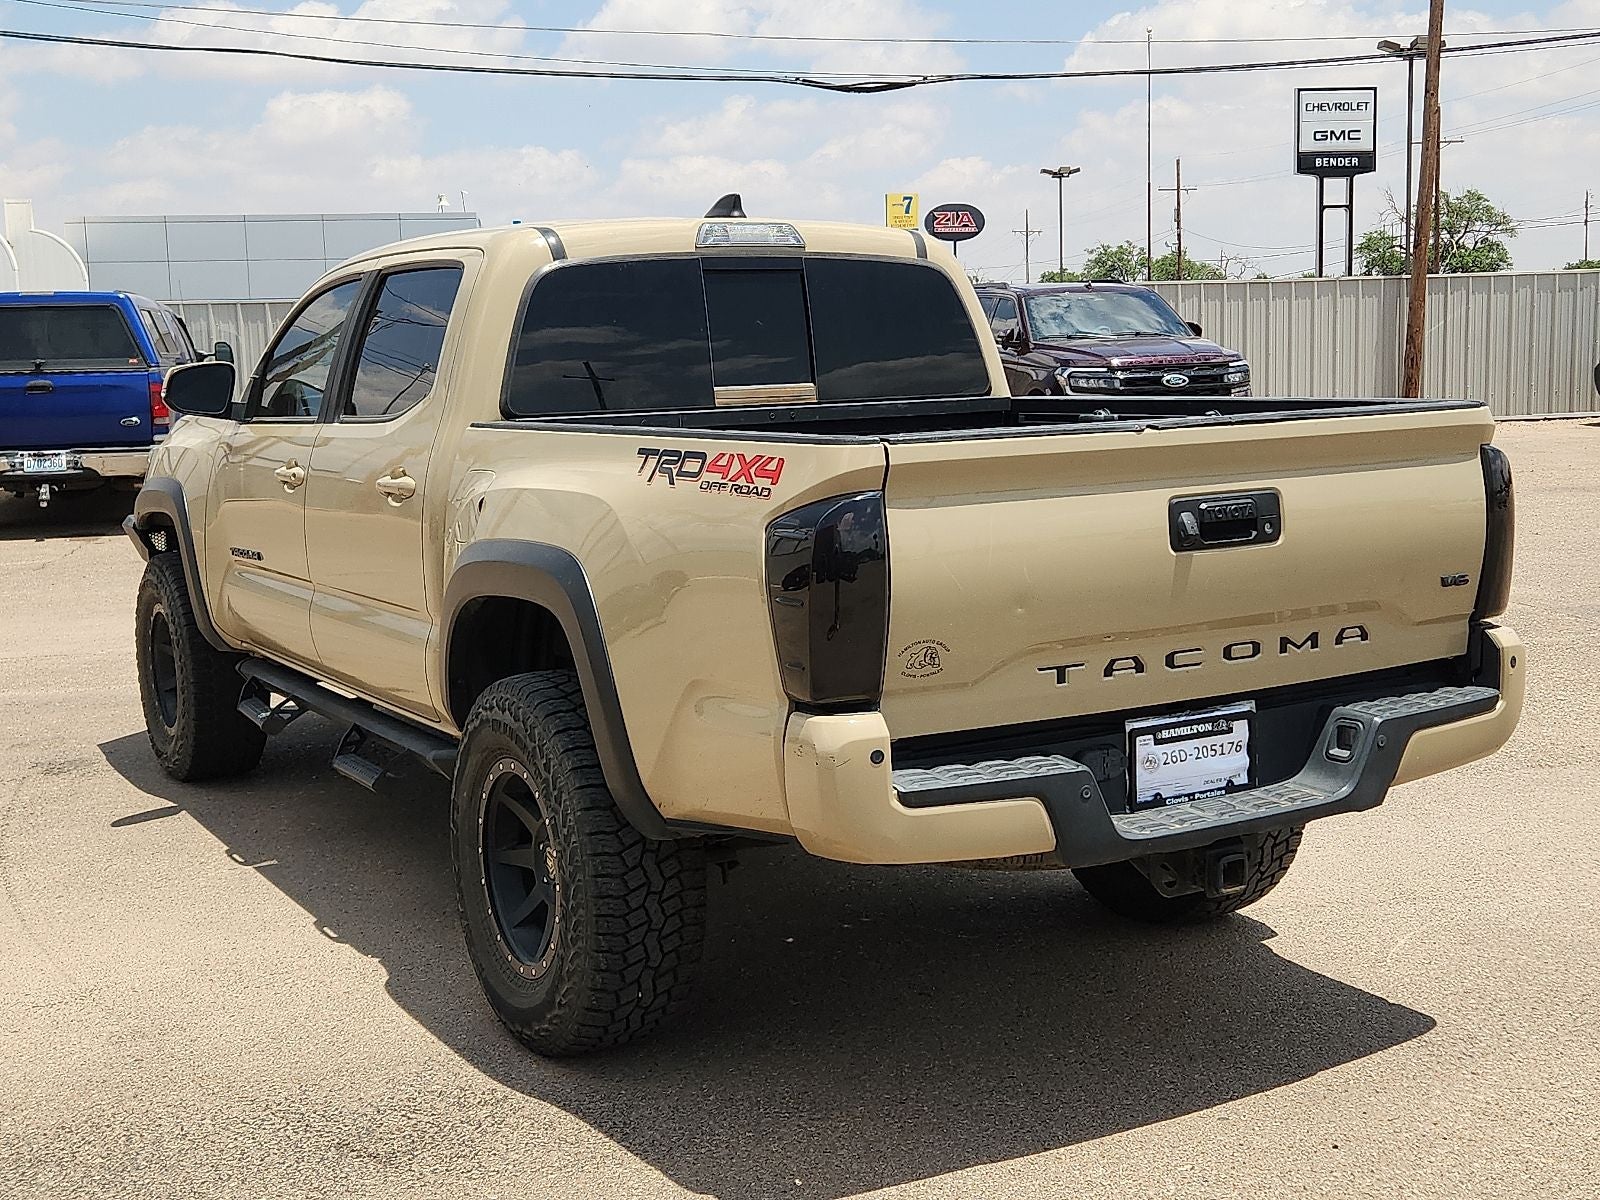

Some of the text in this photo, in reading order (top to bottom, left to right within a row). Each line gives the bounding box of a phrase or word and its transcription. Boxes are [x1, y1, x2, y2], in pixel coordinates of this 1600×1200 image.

[1305, 101, 1371, 112] CHEVROLET
[1313, 129, 1362, 141] GMC
[1315, 157, 1359, 167] BENDER
[902, 195, 914, 215] 7
[933, 211, 976, 227] ZIA
[637, 447, 707, 486] TRD
[699, 480, 772, 500] OFF ROAD
[1206, 503, 1255, 520] TOYOTA
[1036, 624, 1370, 686] TACOMA
[1161, 722, 1213, 739] HAMILTON
[1161, 739, 1243, 766] 26D-205176
[1165, 789, 1226, 806] Clovis Portales
